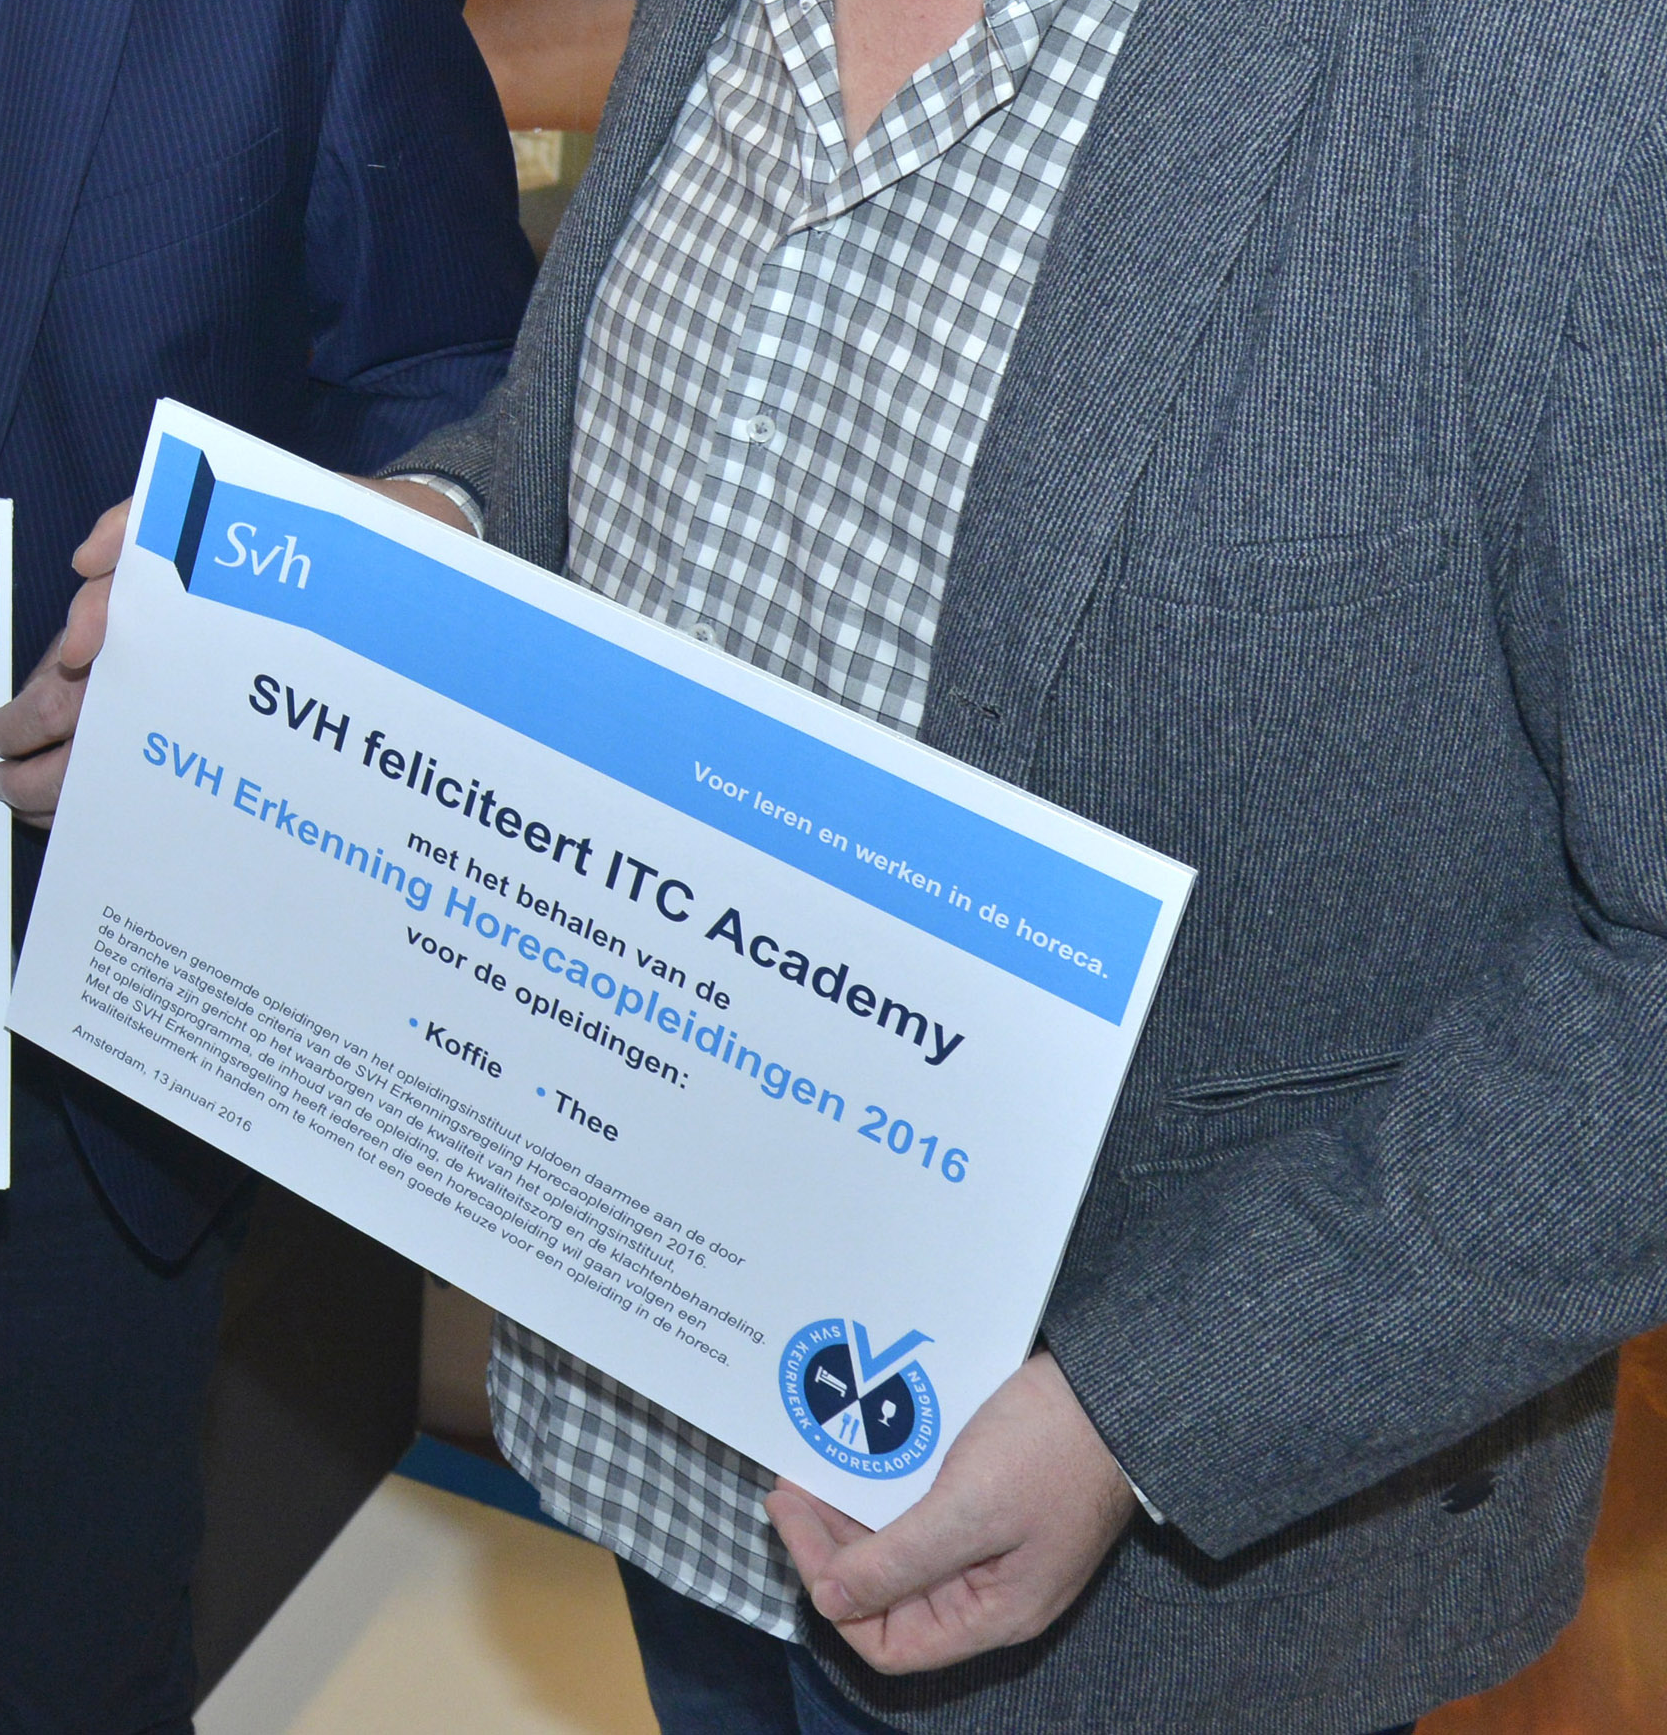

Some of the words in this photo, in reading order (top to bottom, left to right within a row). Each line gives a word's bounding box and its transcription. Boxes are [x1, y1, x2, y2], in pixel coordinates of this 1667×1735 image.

[213, 521, 311, 589] Svh
[142, 731, 224, 796] SVH
[232, 776, 433, 911] Erkenning
[443, 885, 845, 1122] Horecaopleidingen
[856, 1104, 969, 1183] 2016
[248, 673, 350, 753] SVH
[362, 729, 593, 876] feliciteert
[604, 849, 694, 922] ITC
[703, 906, 965, 1066] Academy
[406, 832, 459, 871] met
[464, 856, 509, 897] het
[515, 882, 626, 957] behalen
[636, 948, 686, 988] van
[694, 979, 730, 1010] de
[694, 760, 749, 802] Voor
[752, 790, 812, 834] leren
[818, 827, 848, 852] en
[855, 843, 942, 897] werken
[947, 884, 972, 911] in
[978, 903, 1009, 929] de
[1015, 917, 1108, 979] horeca.
[406, 925, 468, 969] voor
[473, 962, 506, 991] de
[514, 986, 688, 1089] opleidingen:
[424, 1020, 502, 1078] Koffie
[555, 1089, 618, 1142] Thee
